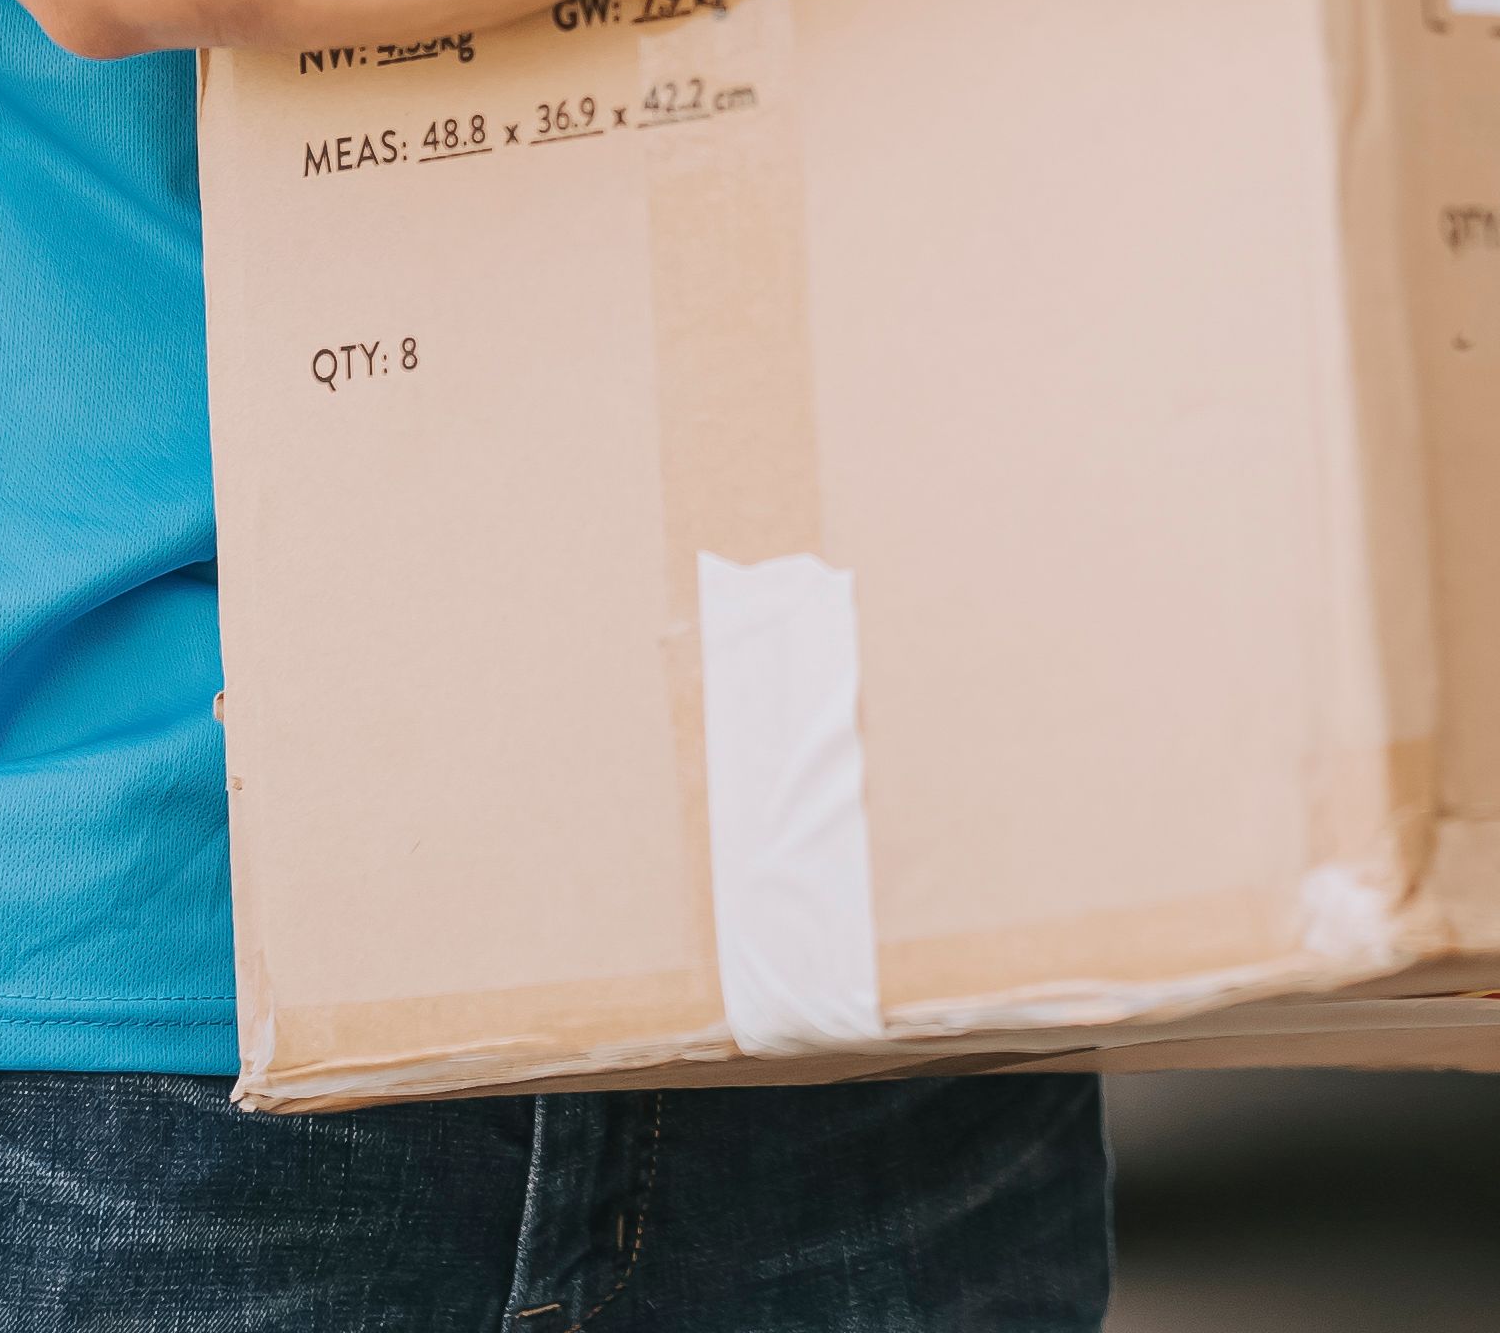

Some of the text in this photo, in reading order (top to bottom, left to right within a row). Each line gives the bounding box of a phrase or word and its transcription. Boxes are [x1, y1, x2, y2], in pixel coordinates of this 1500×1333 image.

[303, 129, 408, 178] MEAS:
[422, 114, 487, 152] 48.8
[536, 96, 597, 134] 36.9
[643, 77, 707, 113] 42.2
[311, 336, 418, 392] QTY: 8
